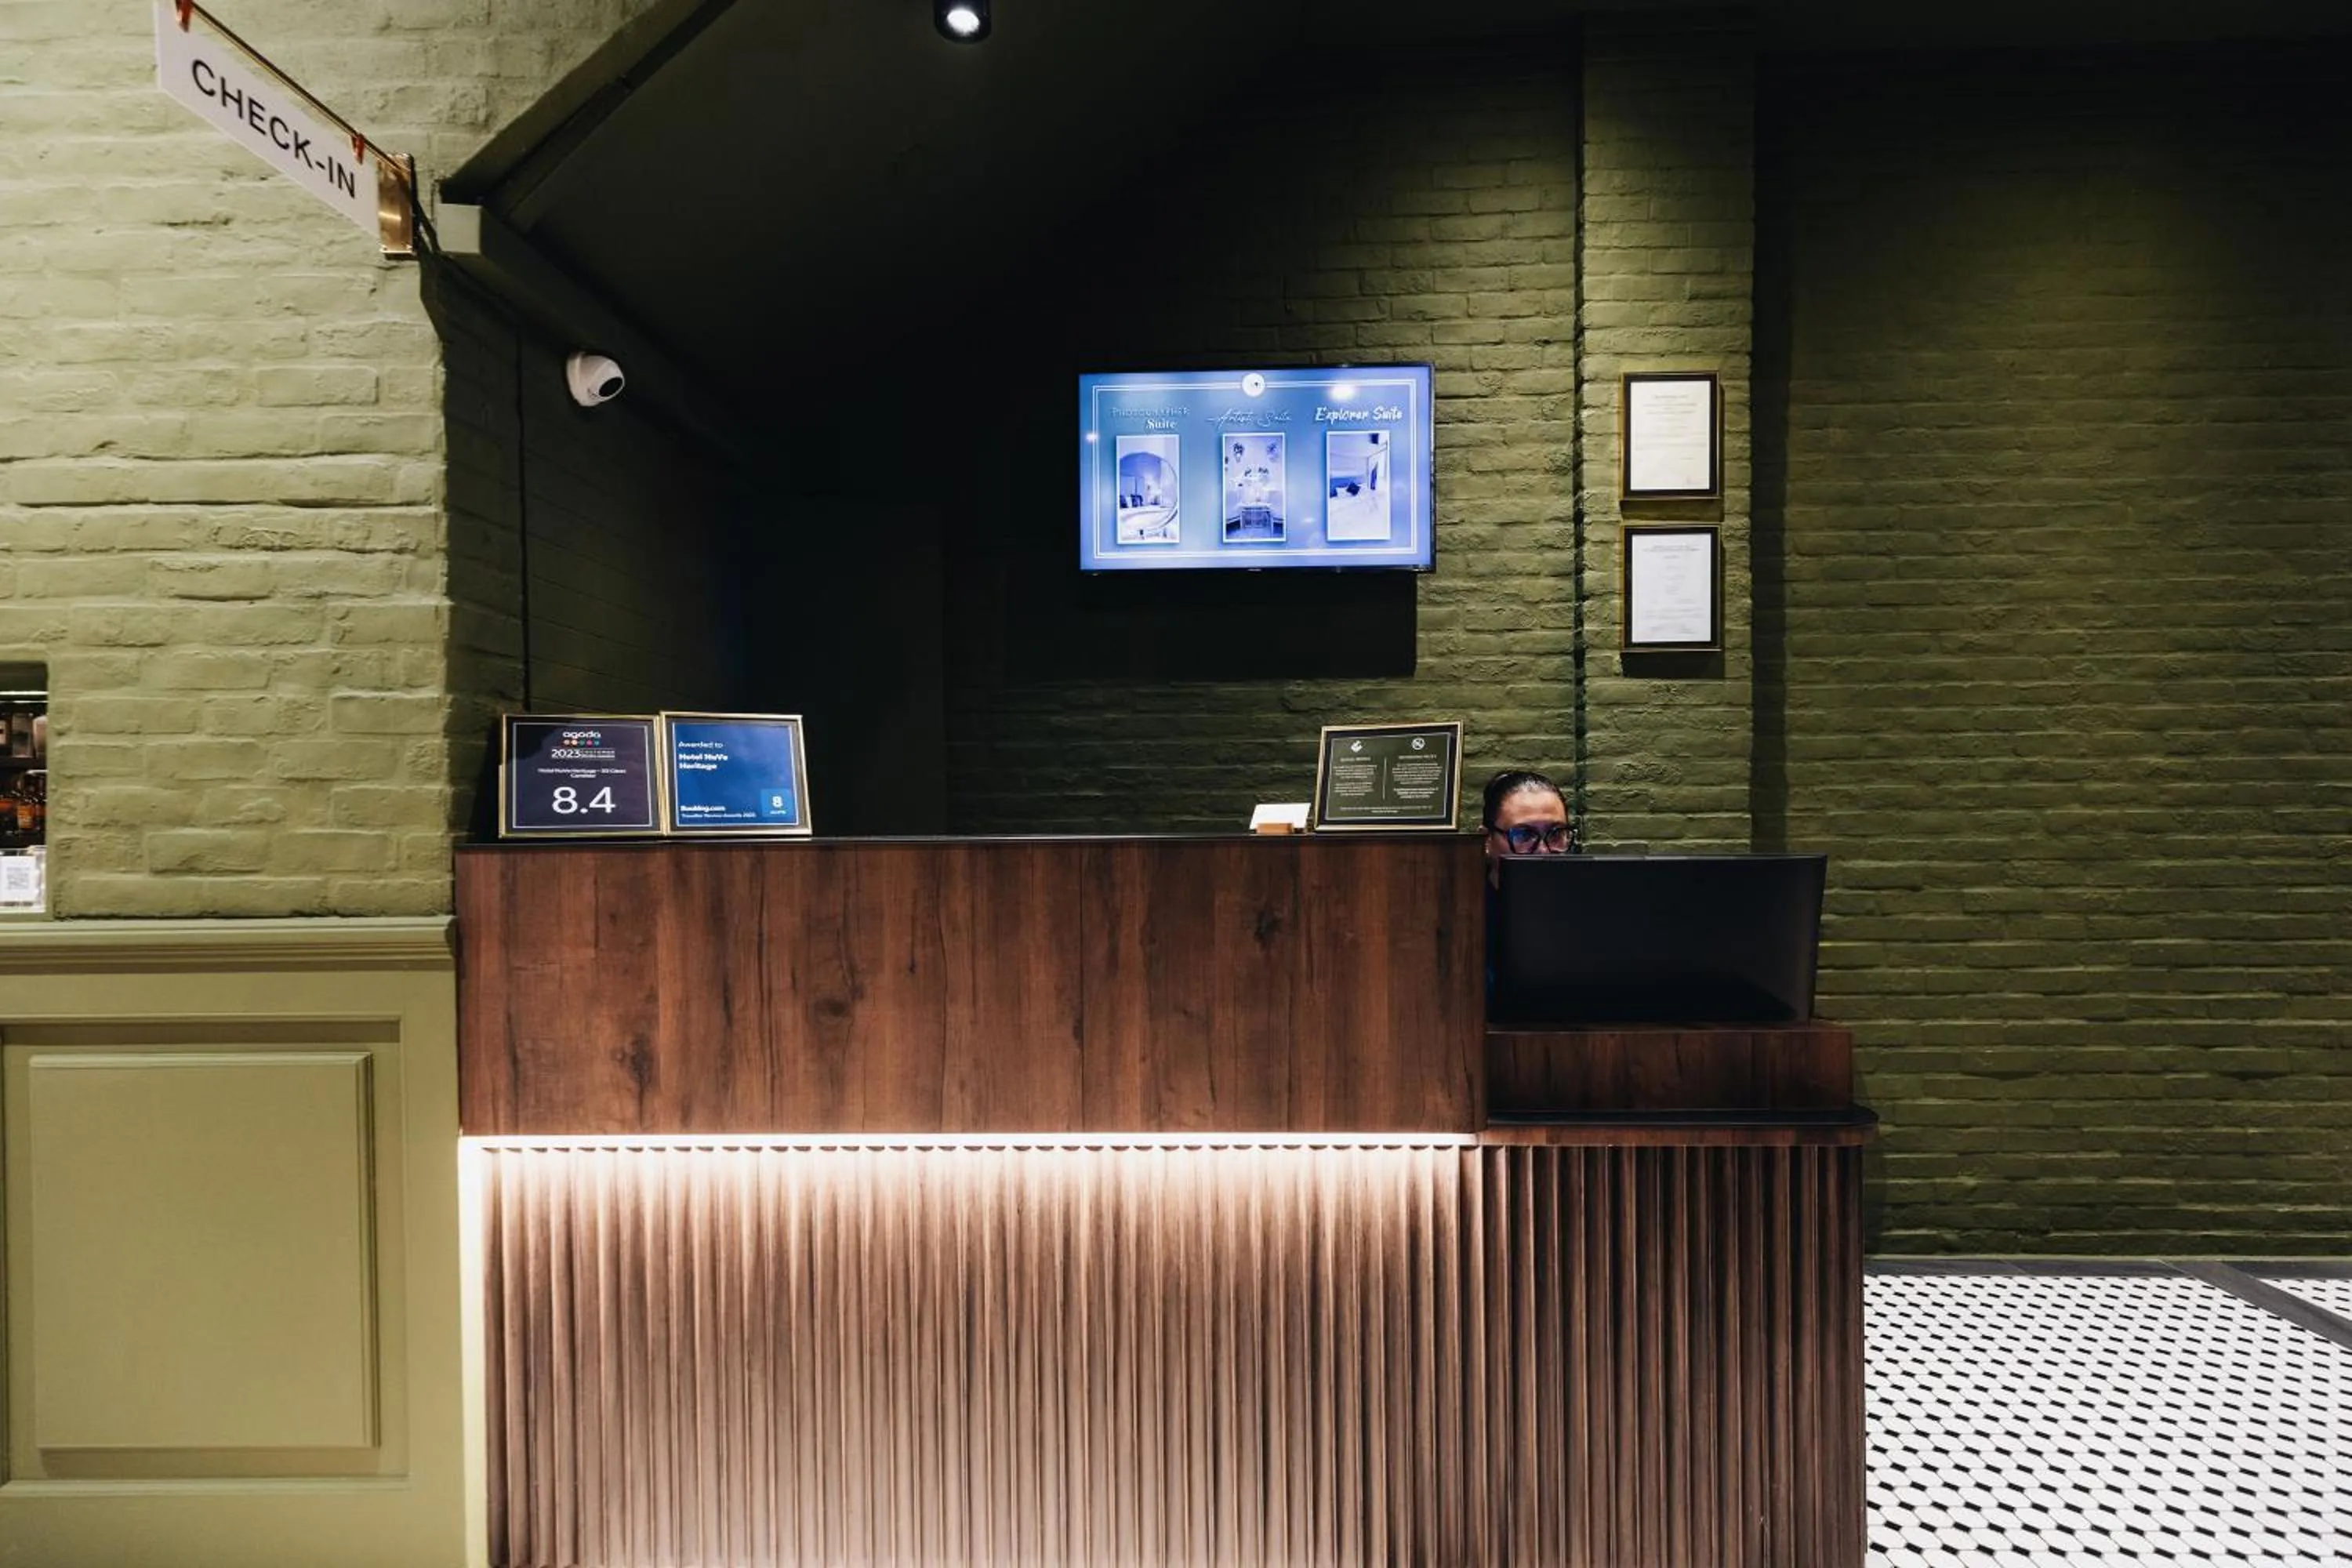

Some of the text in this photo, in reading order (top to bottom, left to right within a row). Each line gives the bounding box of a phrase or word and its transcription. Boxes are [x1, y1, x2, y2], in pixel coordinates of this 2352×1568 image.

[191, 59, 355, 199] CHECK-IN
[1145, 418, 1177, 430] Suite
[1316, 406, 1403, 426] Explorer Suite
[551, 749, 581, 759] 2023
[679, 762, 717, 771] Heritage
[552, 786, 616, 814] 8.4
